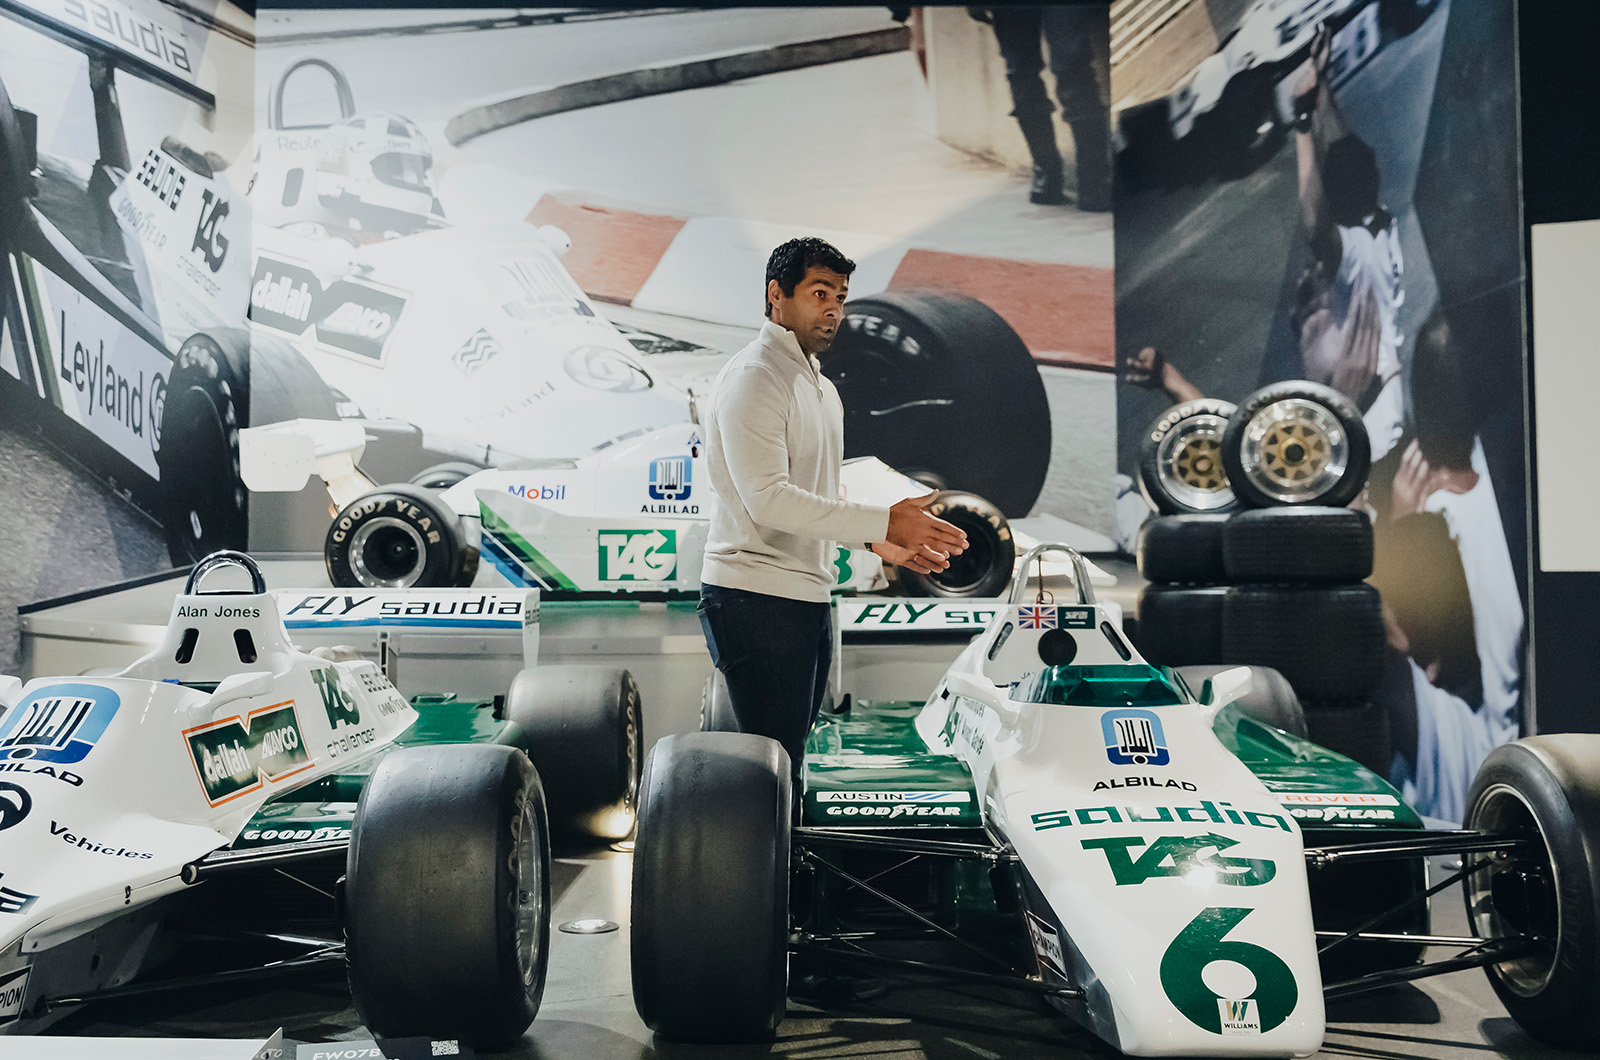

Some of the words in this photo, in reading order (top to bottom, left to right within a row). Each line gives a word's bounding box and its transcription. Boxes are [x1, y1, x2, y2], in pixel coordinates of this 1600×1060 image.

[191, 188, 230, 273] TAG
[251, 271, 312, 322] dallah
[61, 309, 144, 439] Leyland
[508, 484, 566, 500] Mobil
[641, 504, 699, 514] ALBILAD
[599, 529, 678, 581] TAG
[177, 605, 208, 618] Alan
[214, 605, 261, 618] Jones
[286, 595, 377, 616] FLY
[379, 595, 522, 616] saudia
[853, 603, 939, 624] FLY
[310, 665, 360, 730] TAG
[326, 728, 376, 759] challenger
[204, 739, 250, 782] dallah
[829, 792, 904, 801] AUSTIN
[1092, 776, 1198, 793] ALBILAD
[1285, 794, 1378, 803] ROVER
[1030, 800, 1293, 833] saudia
[50, 820, 154, 860] Vehicles
[1080, 831, 1277, 887] TAG
[1160, 906, 1298, 1035] 6
[1223, 1022, 1259, 1030] WILLIAMS
